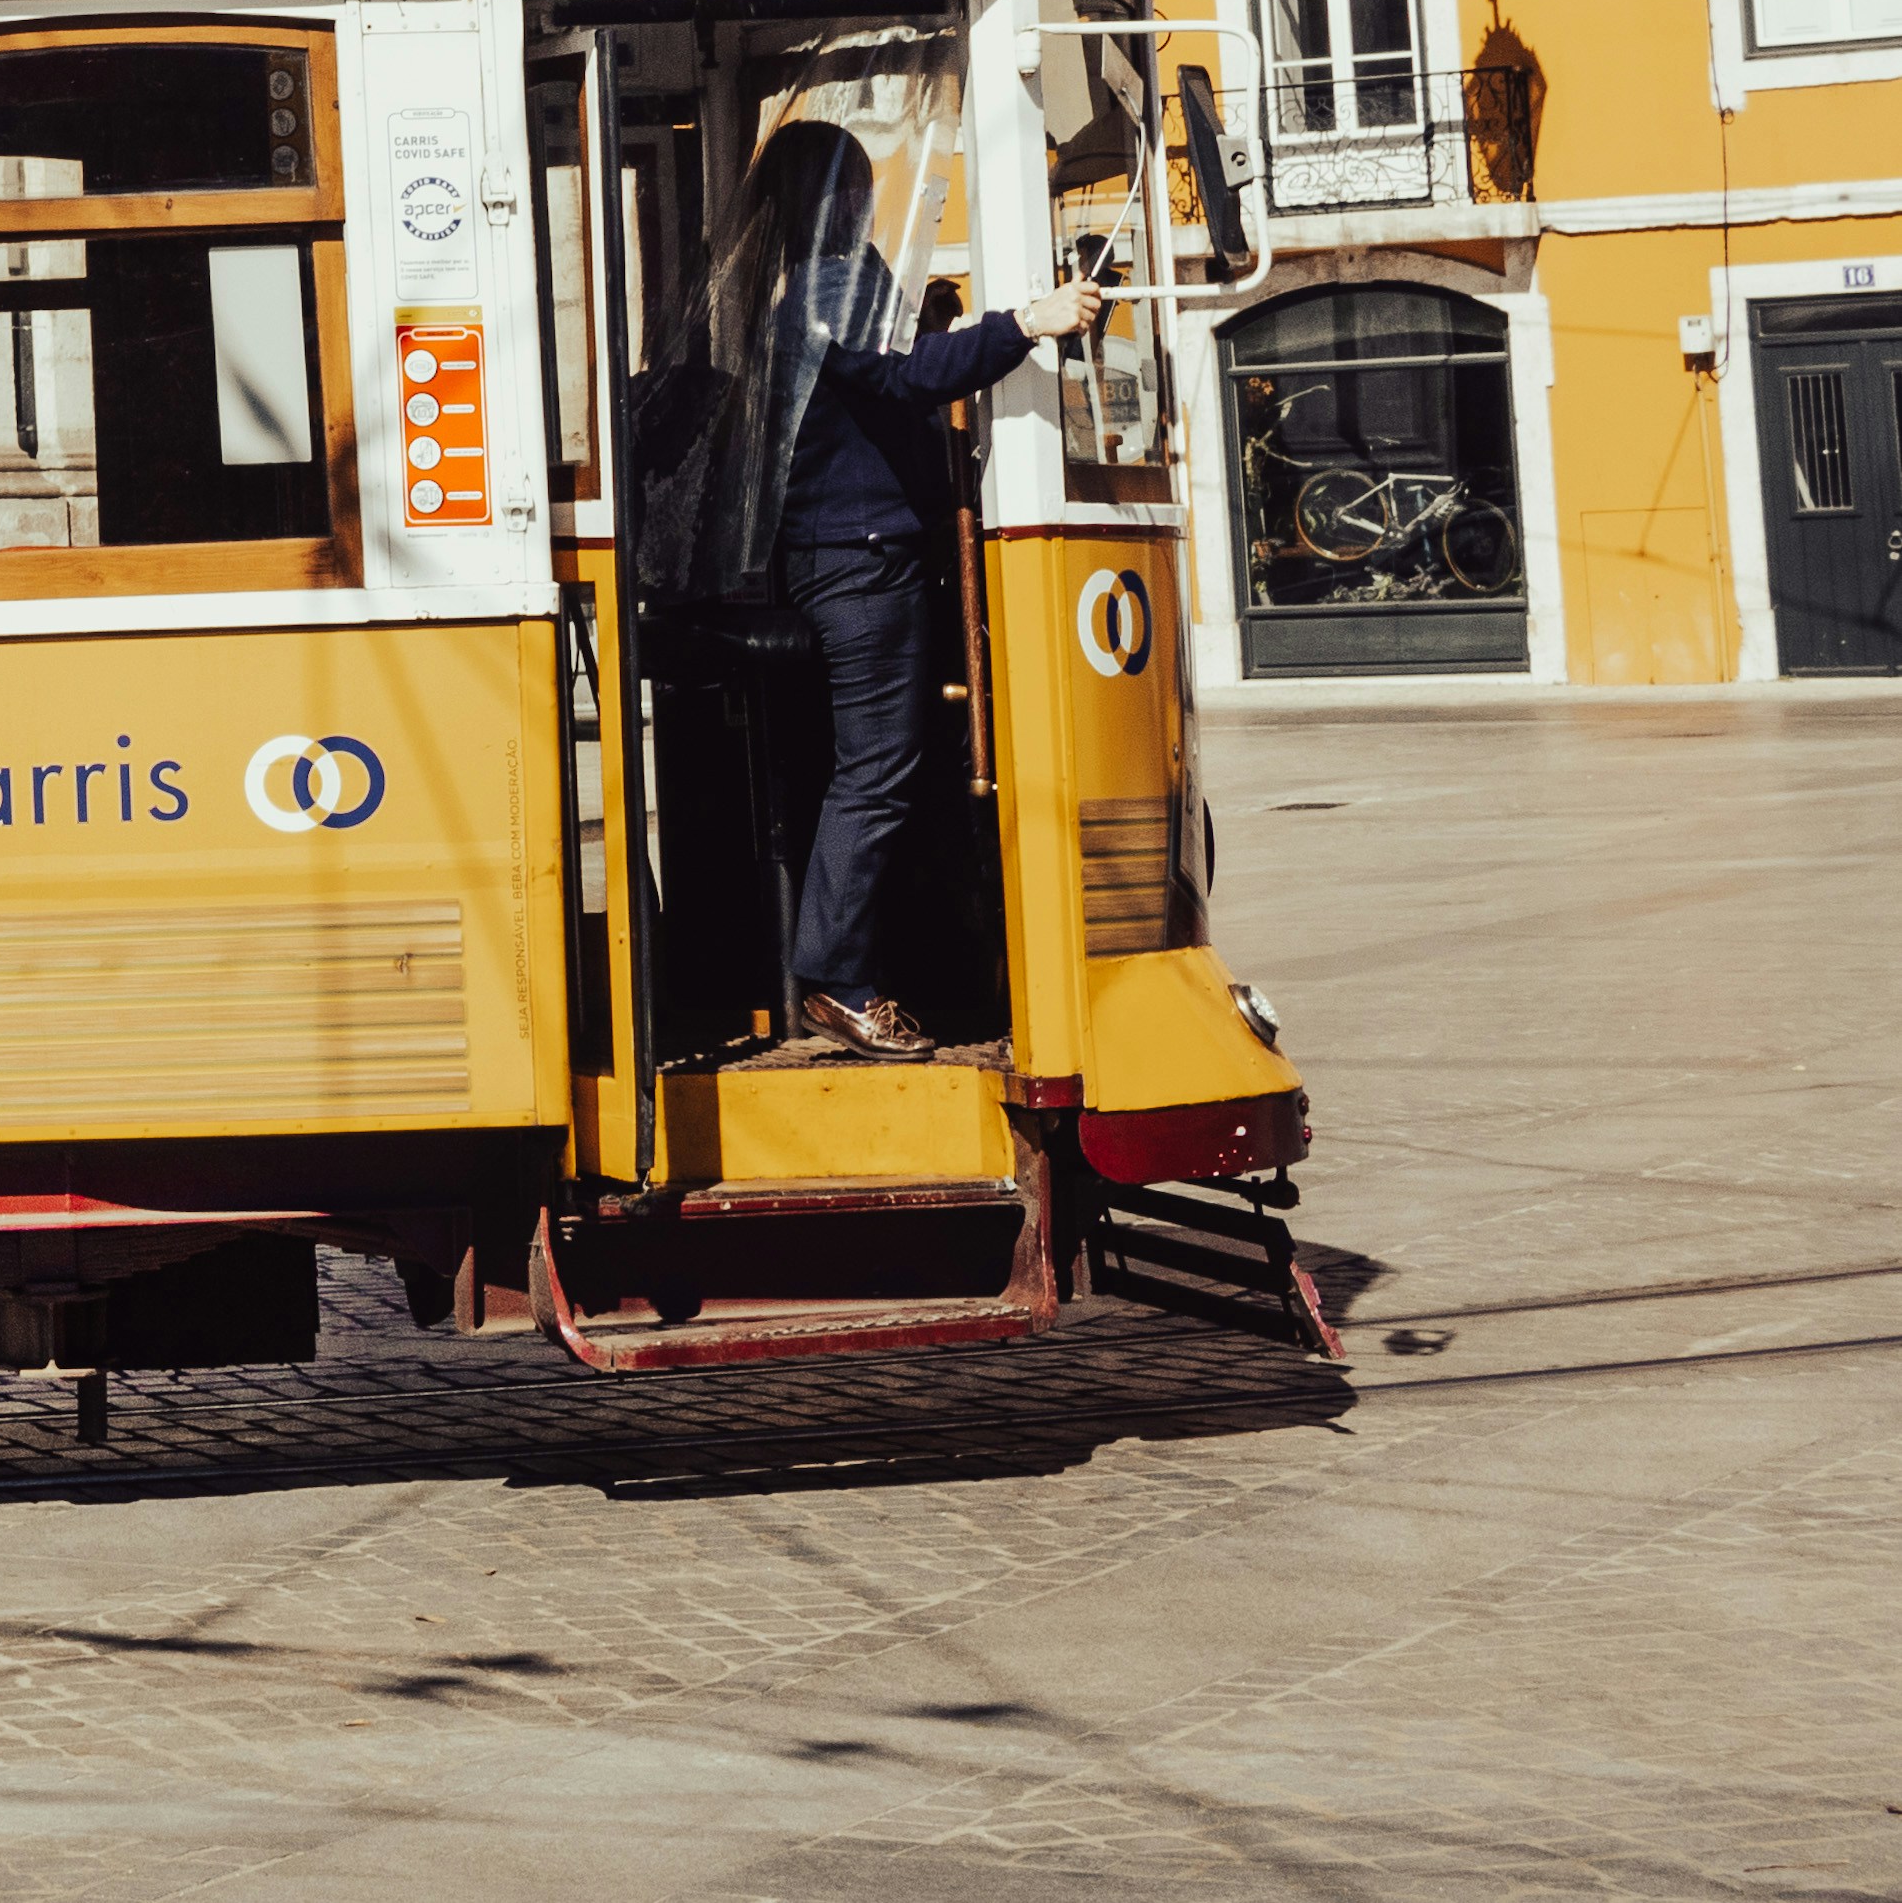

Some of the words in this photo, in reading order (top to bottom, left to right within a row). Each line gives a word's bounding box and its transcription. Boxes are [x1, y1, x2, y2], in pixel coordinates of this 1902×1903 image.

[394, 136, 439, 146] CARRIS
[395, 149, 431, 159] COVID
[434, 148, 466, 158] SAFE
[510, 830, 522, 860] COM
[512, 864, 523, 900] BEBA
[519, 1006, 530, 1040] SEJA
